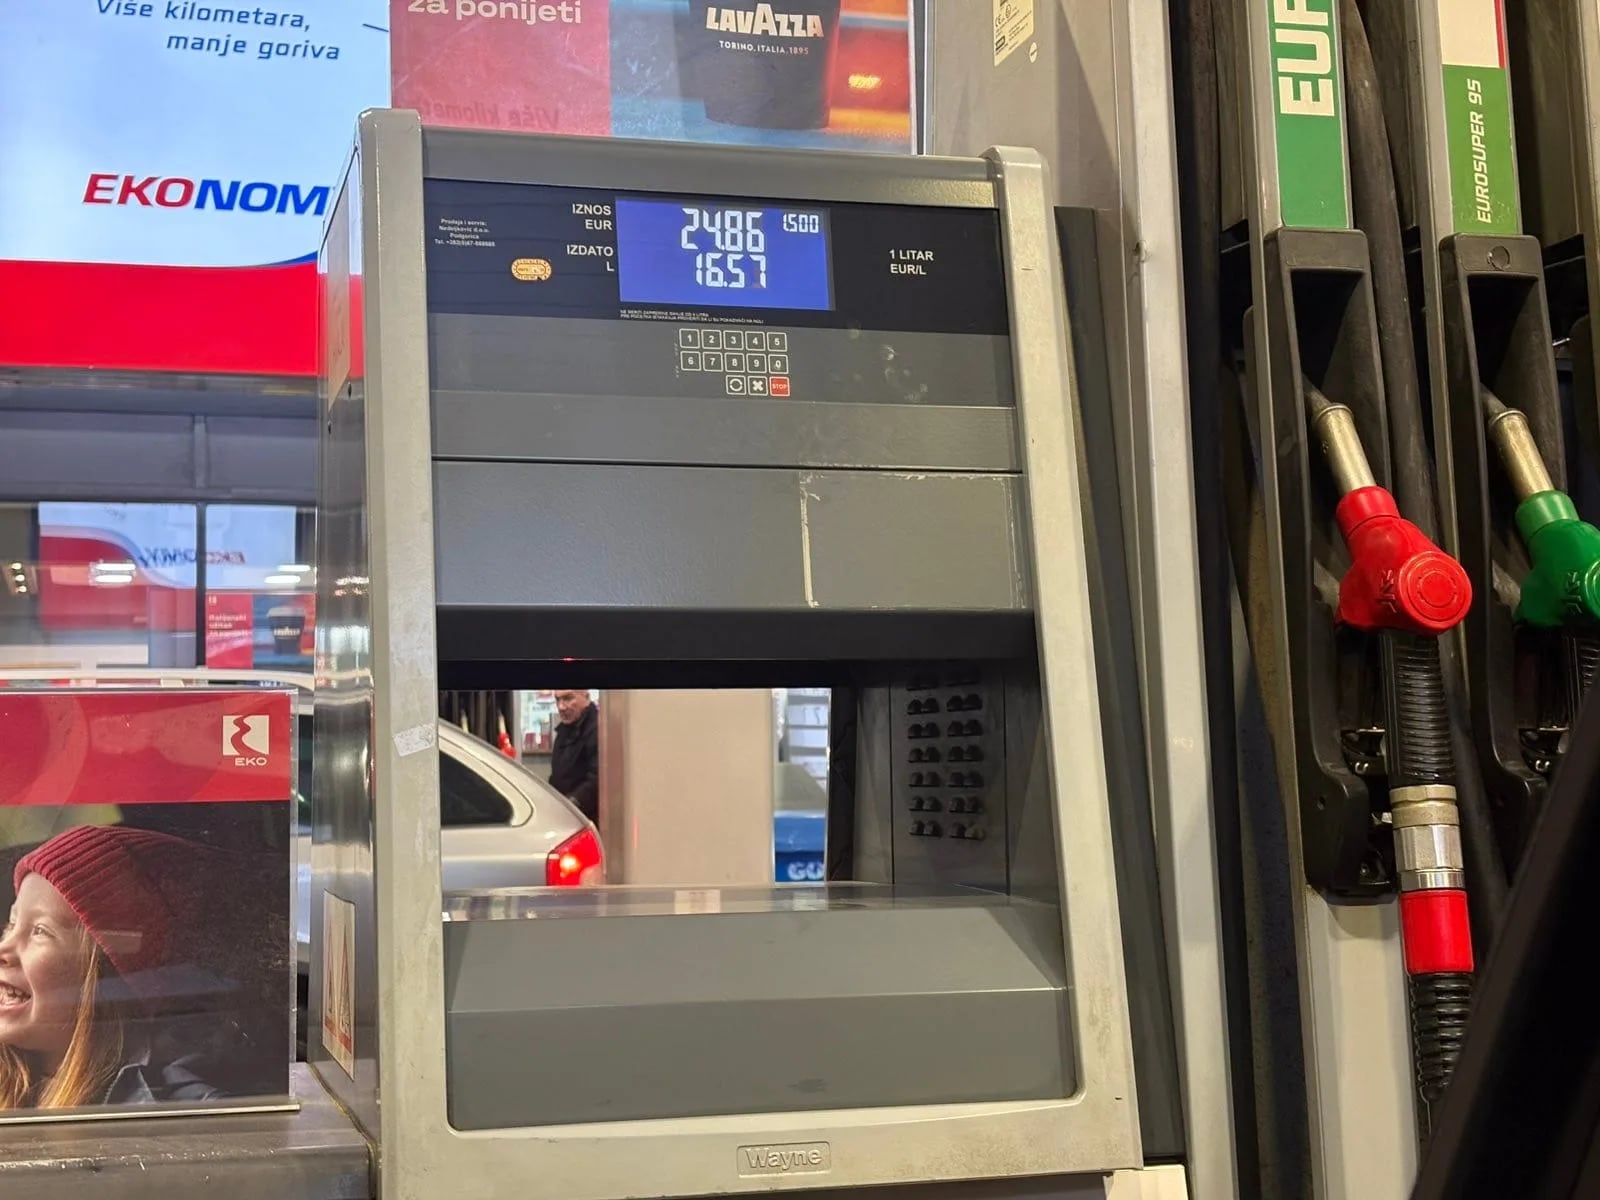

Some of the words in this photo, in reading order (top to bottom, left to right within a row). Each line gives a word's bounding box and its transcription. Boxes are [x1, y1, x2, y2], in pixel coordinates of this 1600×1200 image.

[96, 0, 152, 17] Više
[165, 1, 310, 31] kilometara,
[408, 0, 449, 14] za
[456, 0, 582, 25] ponijeti
[706, 3, 824, 37] LAVAZZA
[166, 34, 247, 56] manje
[257, 40, 341, 60] goriva
[1467, 78, 1482, 105] 95
[1470, 111, 1492, 223] EUROSUPER
[83, 173, 336, 216] EKONOM
[572, 203, 612, 216] IZNOS
[585, 218, 613, 231] EUR
[681, 208, 765, 252] 24.86
[567, 244, 614, 257] IZDATO
[889, 249, 895, 259] 1
[899, 249, 934, 261] LITAR
[606, 261, 615, 272] L
[696, 252, 767, 288] 16.57
[890, 263, 927, 275] EUR/L
[687, 334, 692, 343] 1
[708, 335, 715, 344] 2
[730, 336, 737, 344] 3
[752, 337, 759, 345] 4
[774, 337, 780, 346] 5
[687, 356, 694, 365] 6
[709, 357, 716, 366] 7
[731, 358, 738, 367] 8
[753, 359, 760, 367] 9
[775, 360, 781, 368] 0
[235, 757, 268, 766] EKO
[745, 1147, 823, 1171] Wayne
